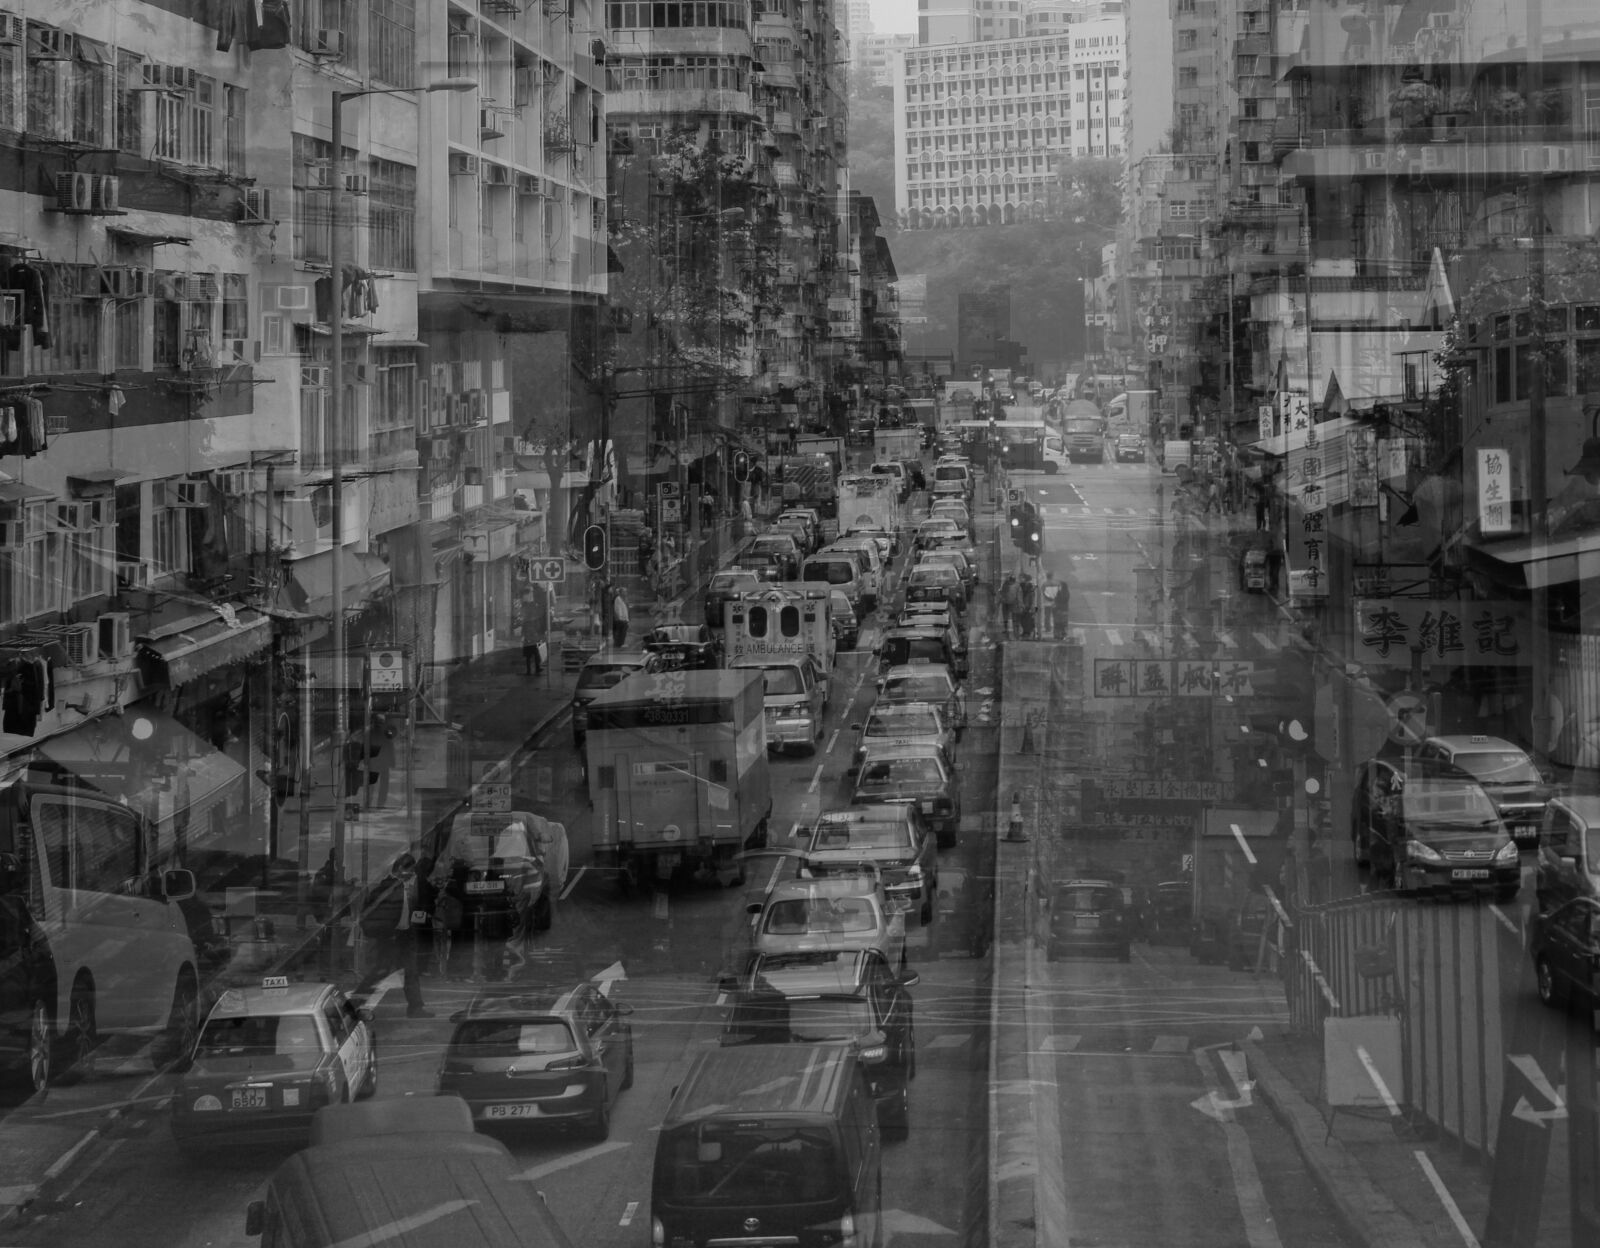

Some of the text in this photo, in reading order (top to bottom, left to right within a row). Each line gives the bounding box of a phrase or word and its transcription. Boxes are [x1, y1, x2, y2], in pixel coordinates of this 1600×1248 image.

[1148, 333, 1168, 353] 押
[1362, 606, 1520, 658] 李維記
[745, 643, 803, 654] AMBULANCE
[265, 978, 286, 987] TAXI
[491, 1105, 531, 1116] PB 277
